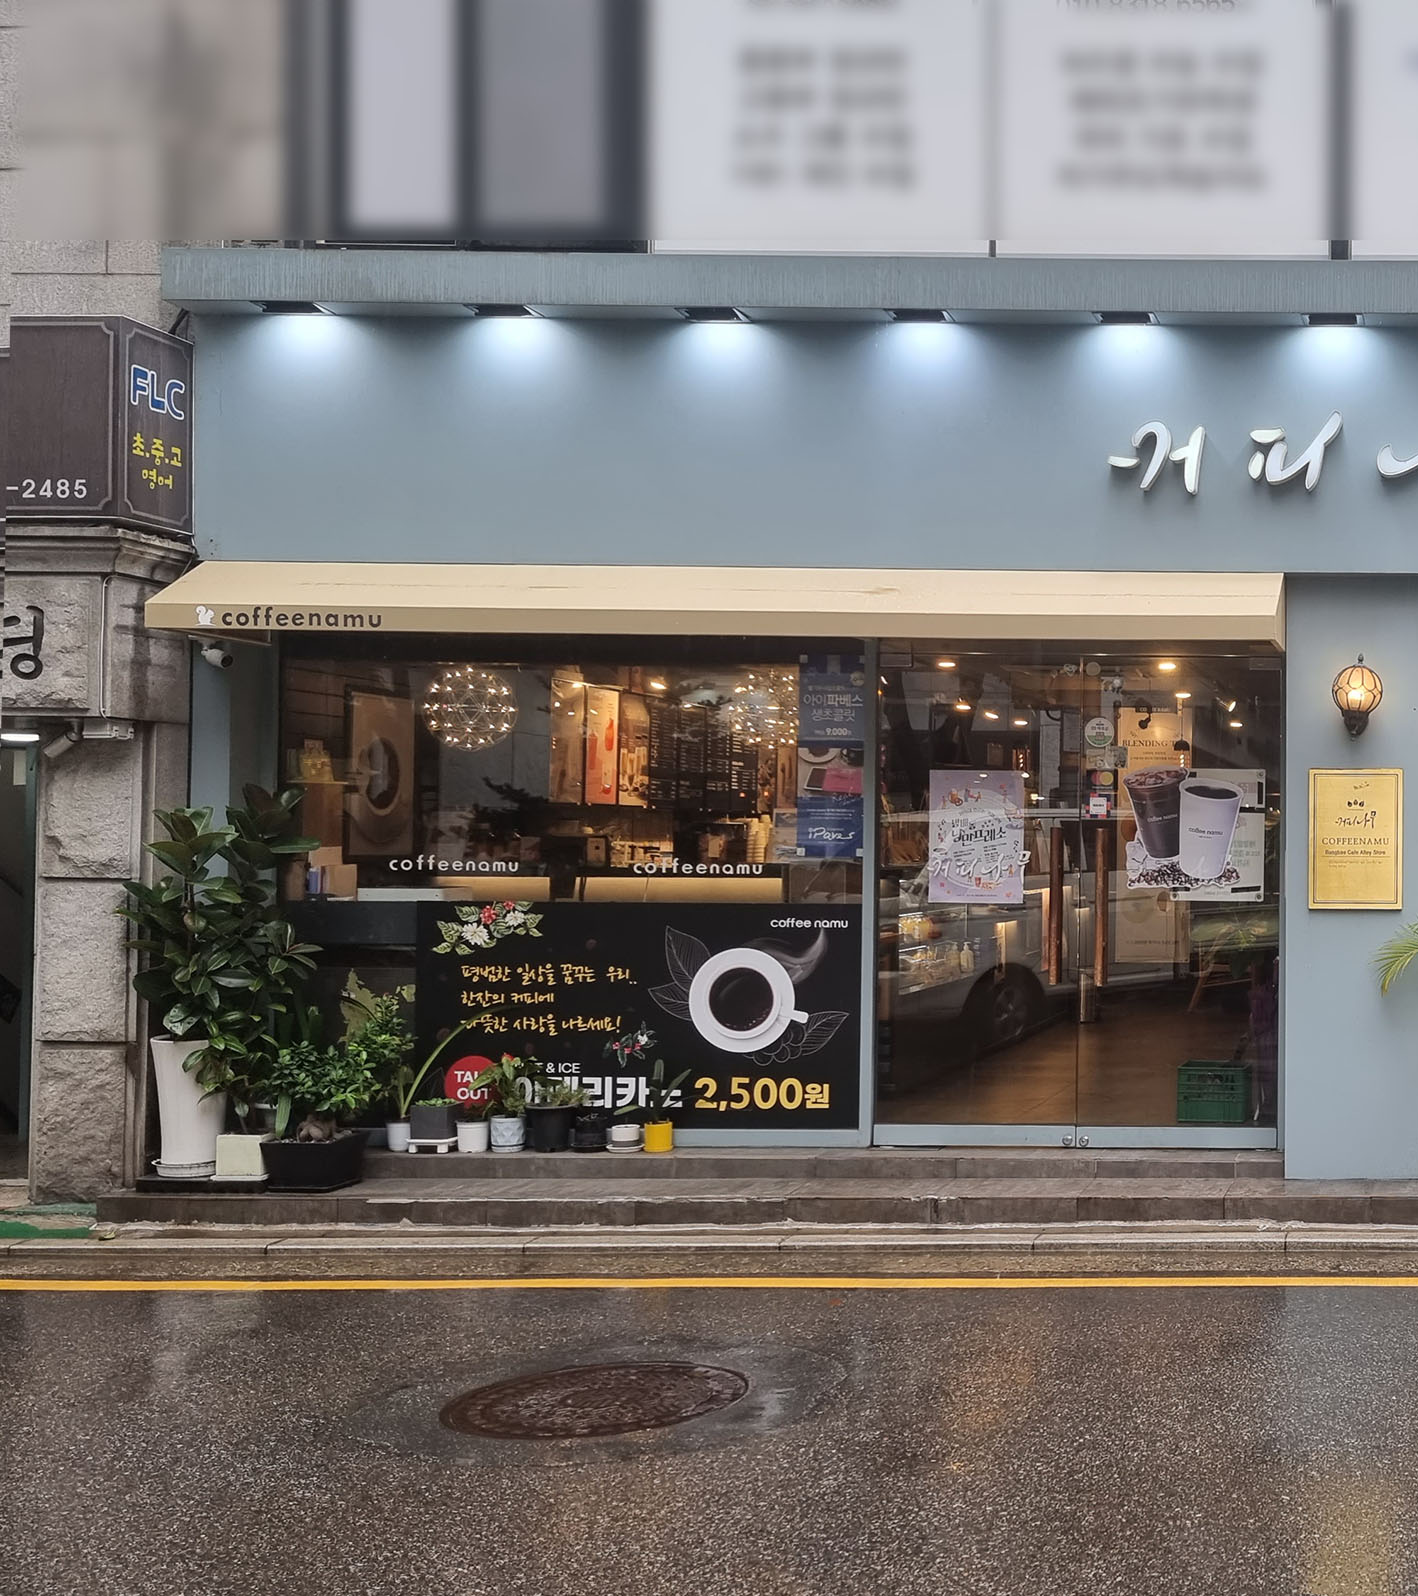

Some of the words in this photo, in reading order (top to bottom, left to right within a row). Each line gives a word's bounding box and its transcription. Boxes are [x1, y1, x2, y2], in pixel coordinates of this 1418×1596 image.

[131, 364, 185, 420] FLC
[132, 432, 182, 467] 초.중.고
[142, 468, 173, 490] 영어
[221, 606, 383, 628] coffeenamu
[1321, 837, 1390, 846] COFFEENAMU
[388, 854, 520, 873] coffeenamu
[632, 857, 764, 876] coffeenamu
[770, 917, 812, 929] coffee
[814, 919, 849, 929] namu
[460, 964, 512, 982] 평범한
[516, 963, 557, 986] 일상을
[560, 964, 597, 985] 꿈꾸는
[460, 991, 505, 1007] 한잔의
[510, 991, 555, 1005] 커피에
[513, 1013, 558, 1036] 사랑을
[562, 1015, 622, 1033] 나르세요!
[545, 1062, 556, 1074] &
[558, 1062, 582, 1074] ICE
[694, 1076, 830, 1112] 2,500원
